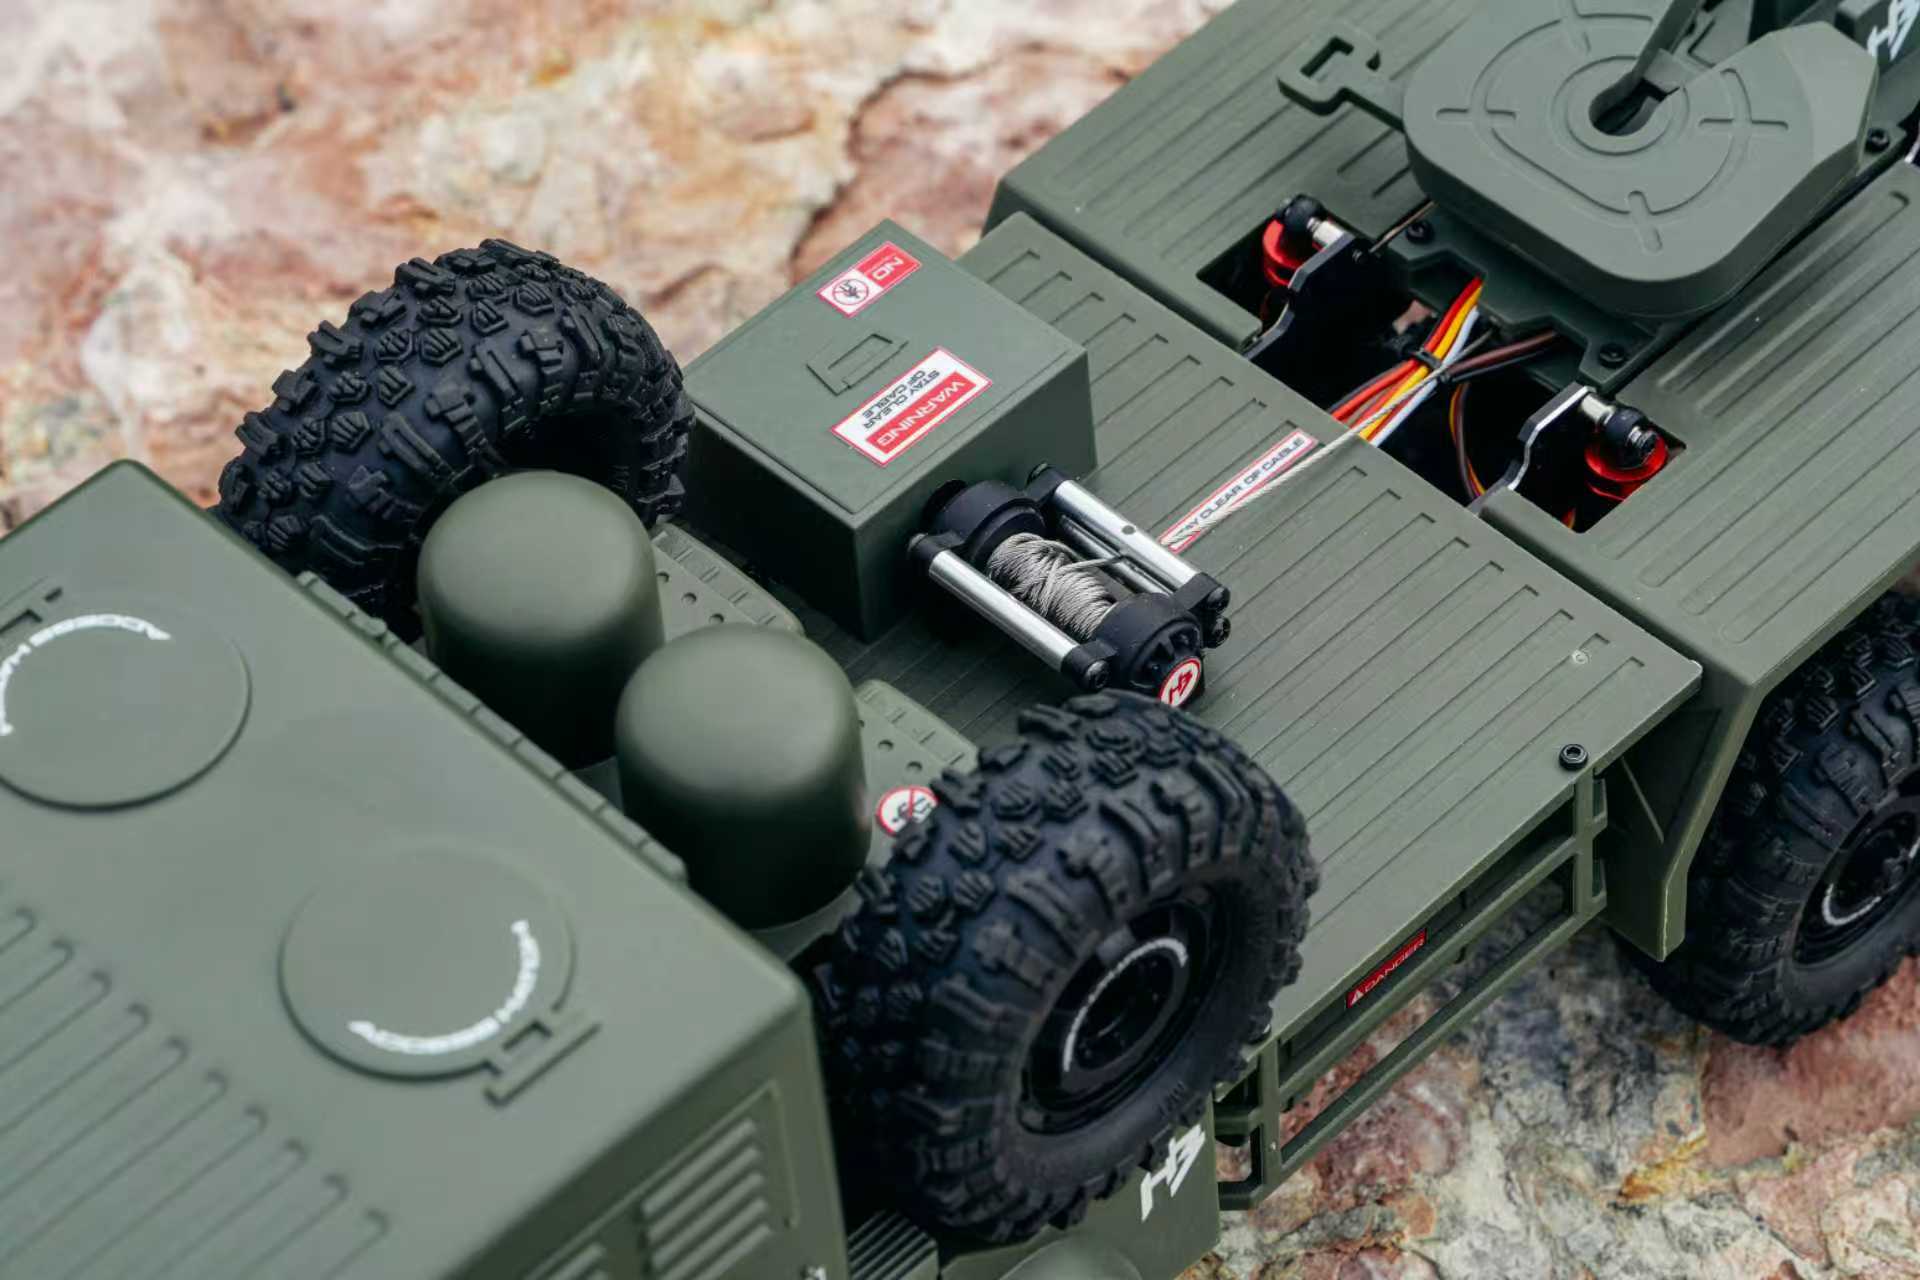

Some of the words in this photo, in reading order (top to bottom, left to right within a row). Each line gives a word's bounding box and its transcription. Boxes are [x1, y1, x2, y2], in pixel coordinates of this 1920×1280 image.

[871, 255, 904, 281] NO
[905, 370, 925, 386] OF
[907, 370, 940, 396] STAY
[861, 384, 907, 419] CABLE
[862, 393, 908, 430] CLEAR
[875, 380, 965, 446] WARNING
[1199, 485, 1242, 519] CLEAR
[1243, 469, 1262, 485] OF
[1261, 436, 1305, 470] CABLE
